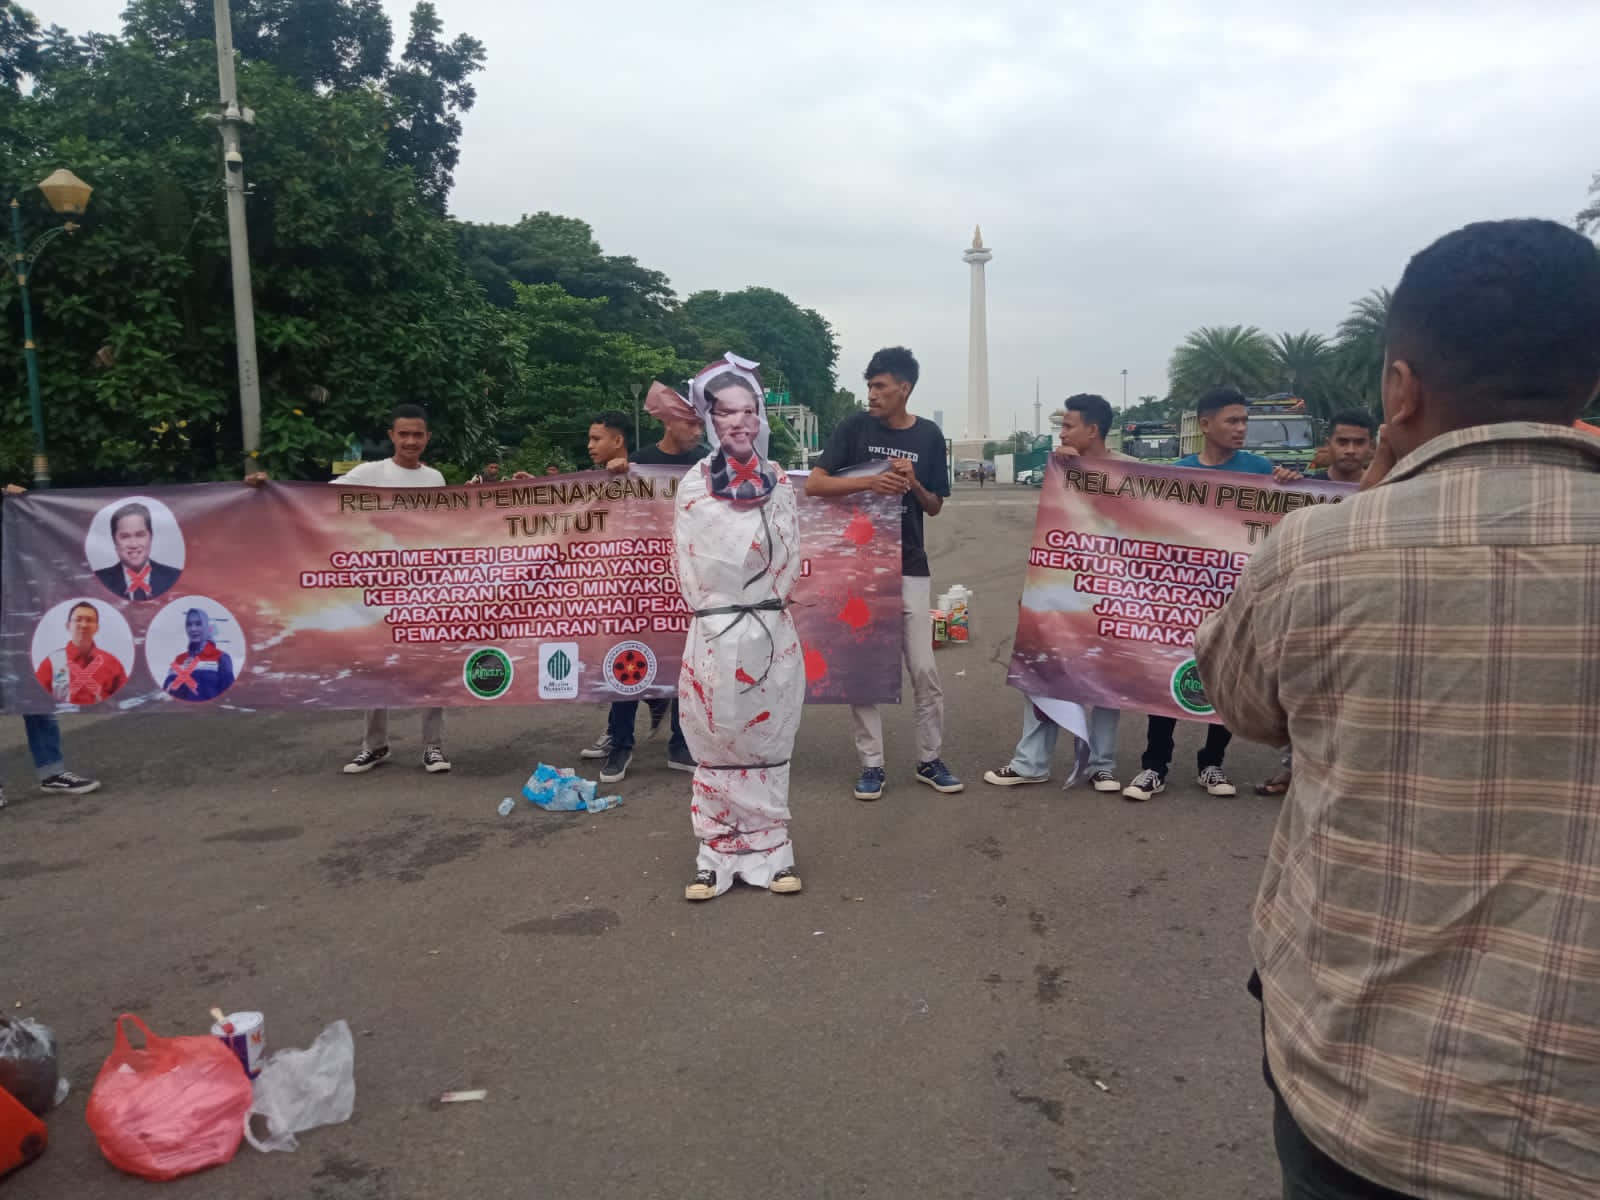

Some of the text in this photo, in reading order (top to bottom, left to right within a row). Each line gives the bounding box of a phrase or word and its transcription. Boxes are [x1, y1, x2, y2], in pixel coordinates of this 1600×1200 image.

[868, 446, 919, 463] UNLIMITED
[339, 491, 469, 512] RELAWAN
[478, 477, 655, 508] PEMENANGAN
[1064, 468, 1209, 506] RELAWAN
[505, 509, 609, 537] TUNTUT
[331, 551, 398, 568] GANTI
[402, 547, 495, 566] MENTERI
[499, 543, 567, 563] BUMN,
[1047, 531, 1117, 555] GANTI
[1120, 539, 1227, 568] MENTERI
[301, 570, 409, 588] DIREKTUR
[411, 567, 486, 585] UTAMA
[488, 561, 606, 582] PERTAMINA
[608, 558, 666, 575] YANG
[1128, 561, 1213, 588] UTAMA
[364, 586, 494, 606] KEBAKARAN
[499, 581, 582, 601] KILANG
[583, 577, 660, 597] MINYAK
[1075, 574, 1223, 609] KEBAKARAN
[385, 605, 479, 624] JABATAN
[482, 601, 562, 621] KALIAN
[565, 598, 633, 616] WAHAI
[1094, 598, 1203, 626] JABATAN
[393, 624, 496, 643] PEMAKAN
[500, 619, 598, 639] MILIARAN
[600, 616, 649, 635] TIAP
